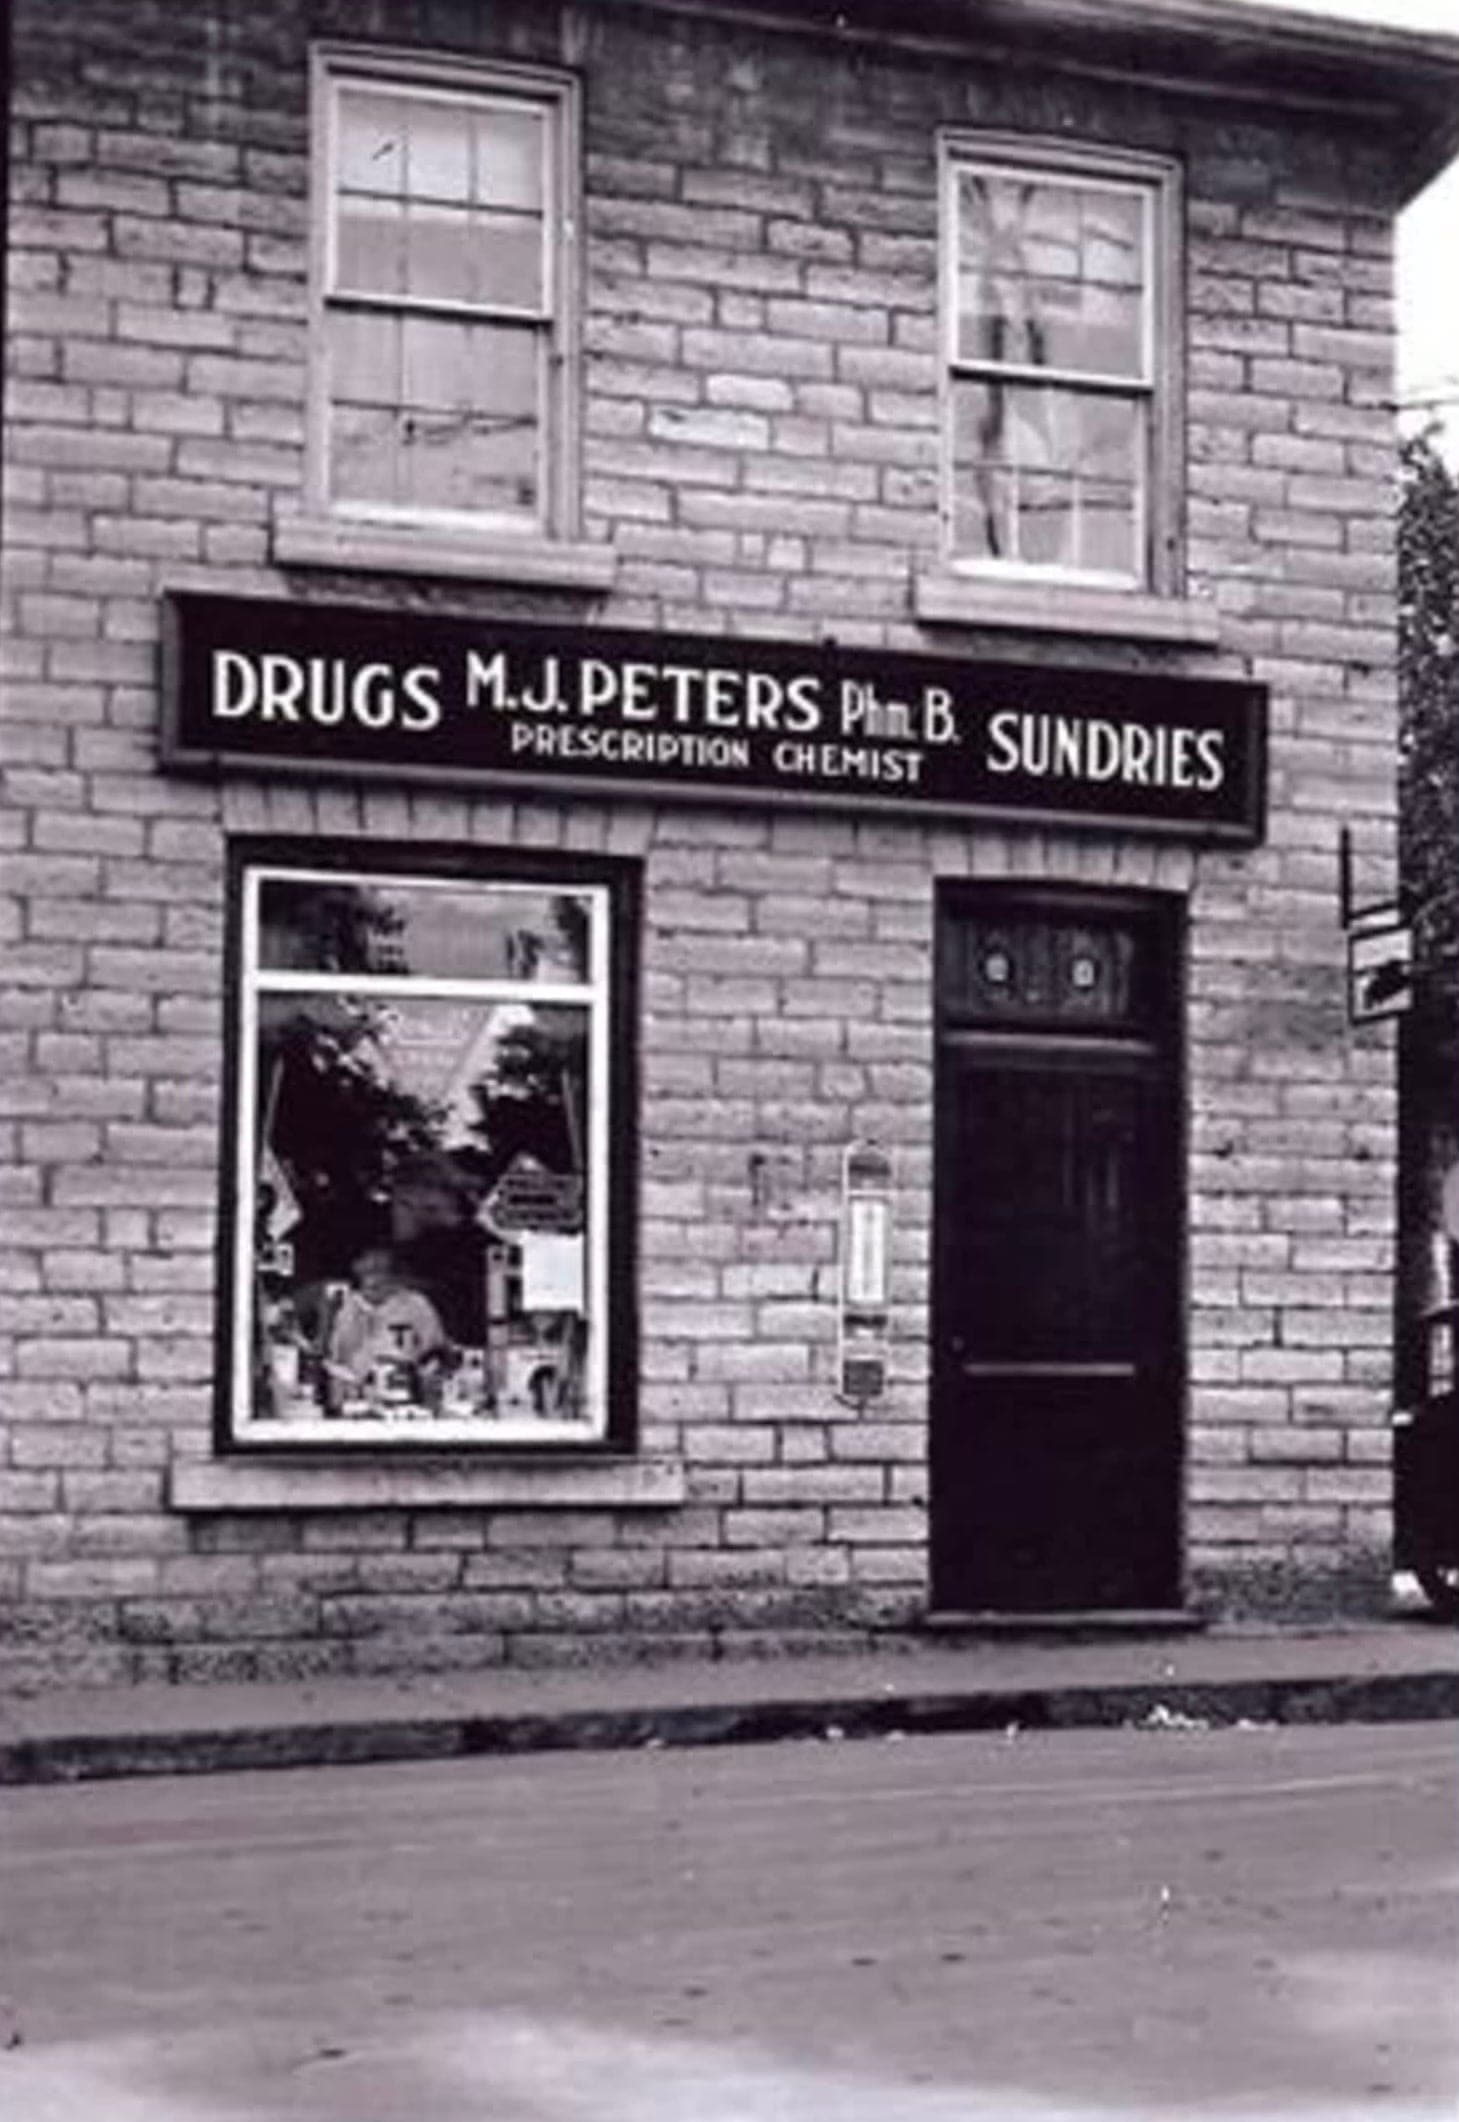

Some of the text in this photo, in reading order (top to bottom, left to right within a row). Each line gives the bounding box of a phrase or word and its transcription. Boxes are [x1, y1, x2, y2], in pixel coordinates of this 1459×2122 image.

[213, 650, 441, 731] DRUGS
[580, 659, 822, 732] PETERS
[512, 722, 922, 782] PRESCRIPTION CHEMIST
[987, 712, 1224, 790] SUNDRIES
